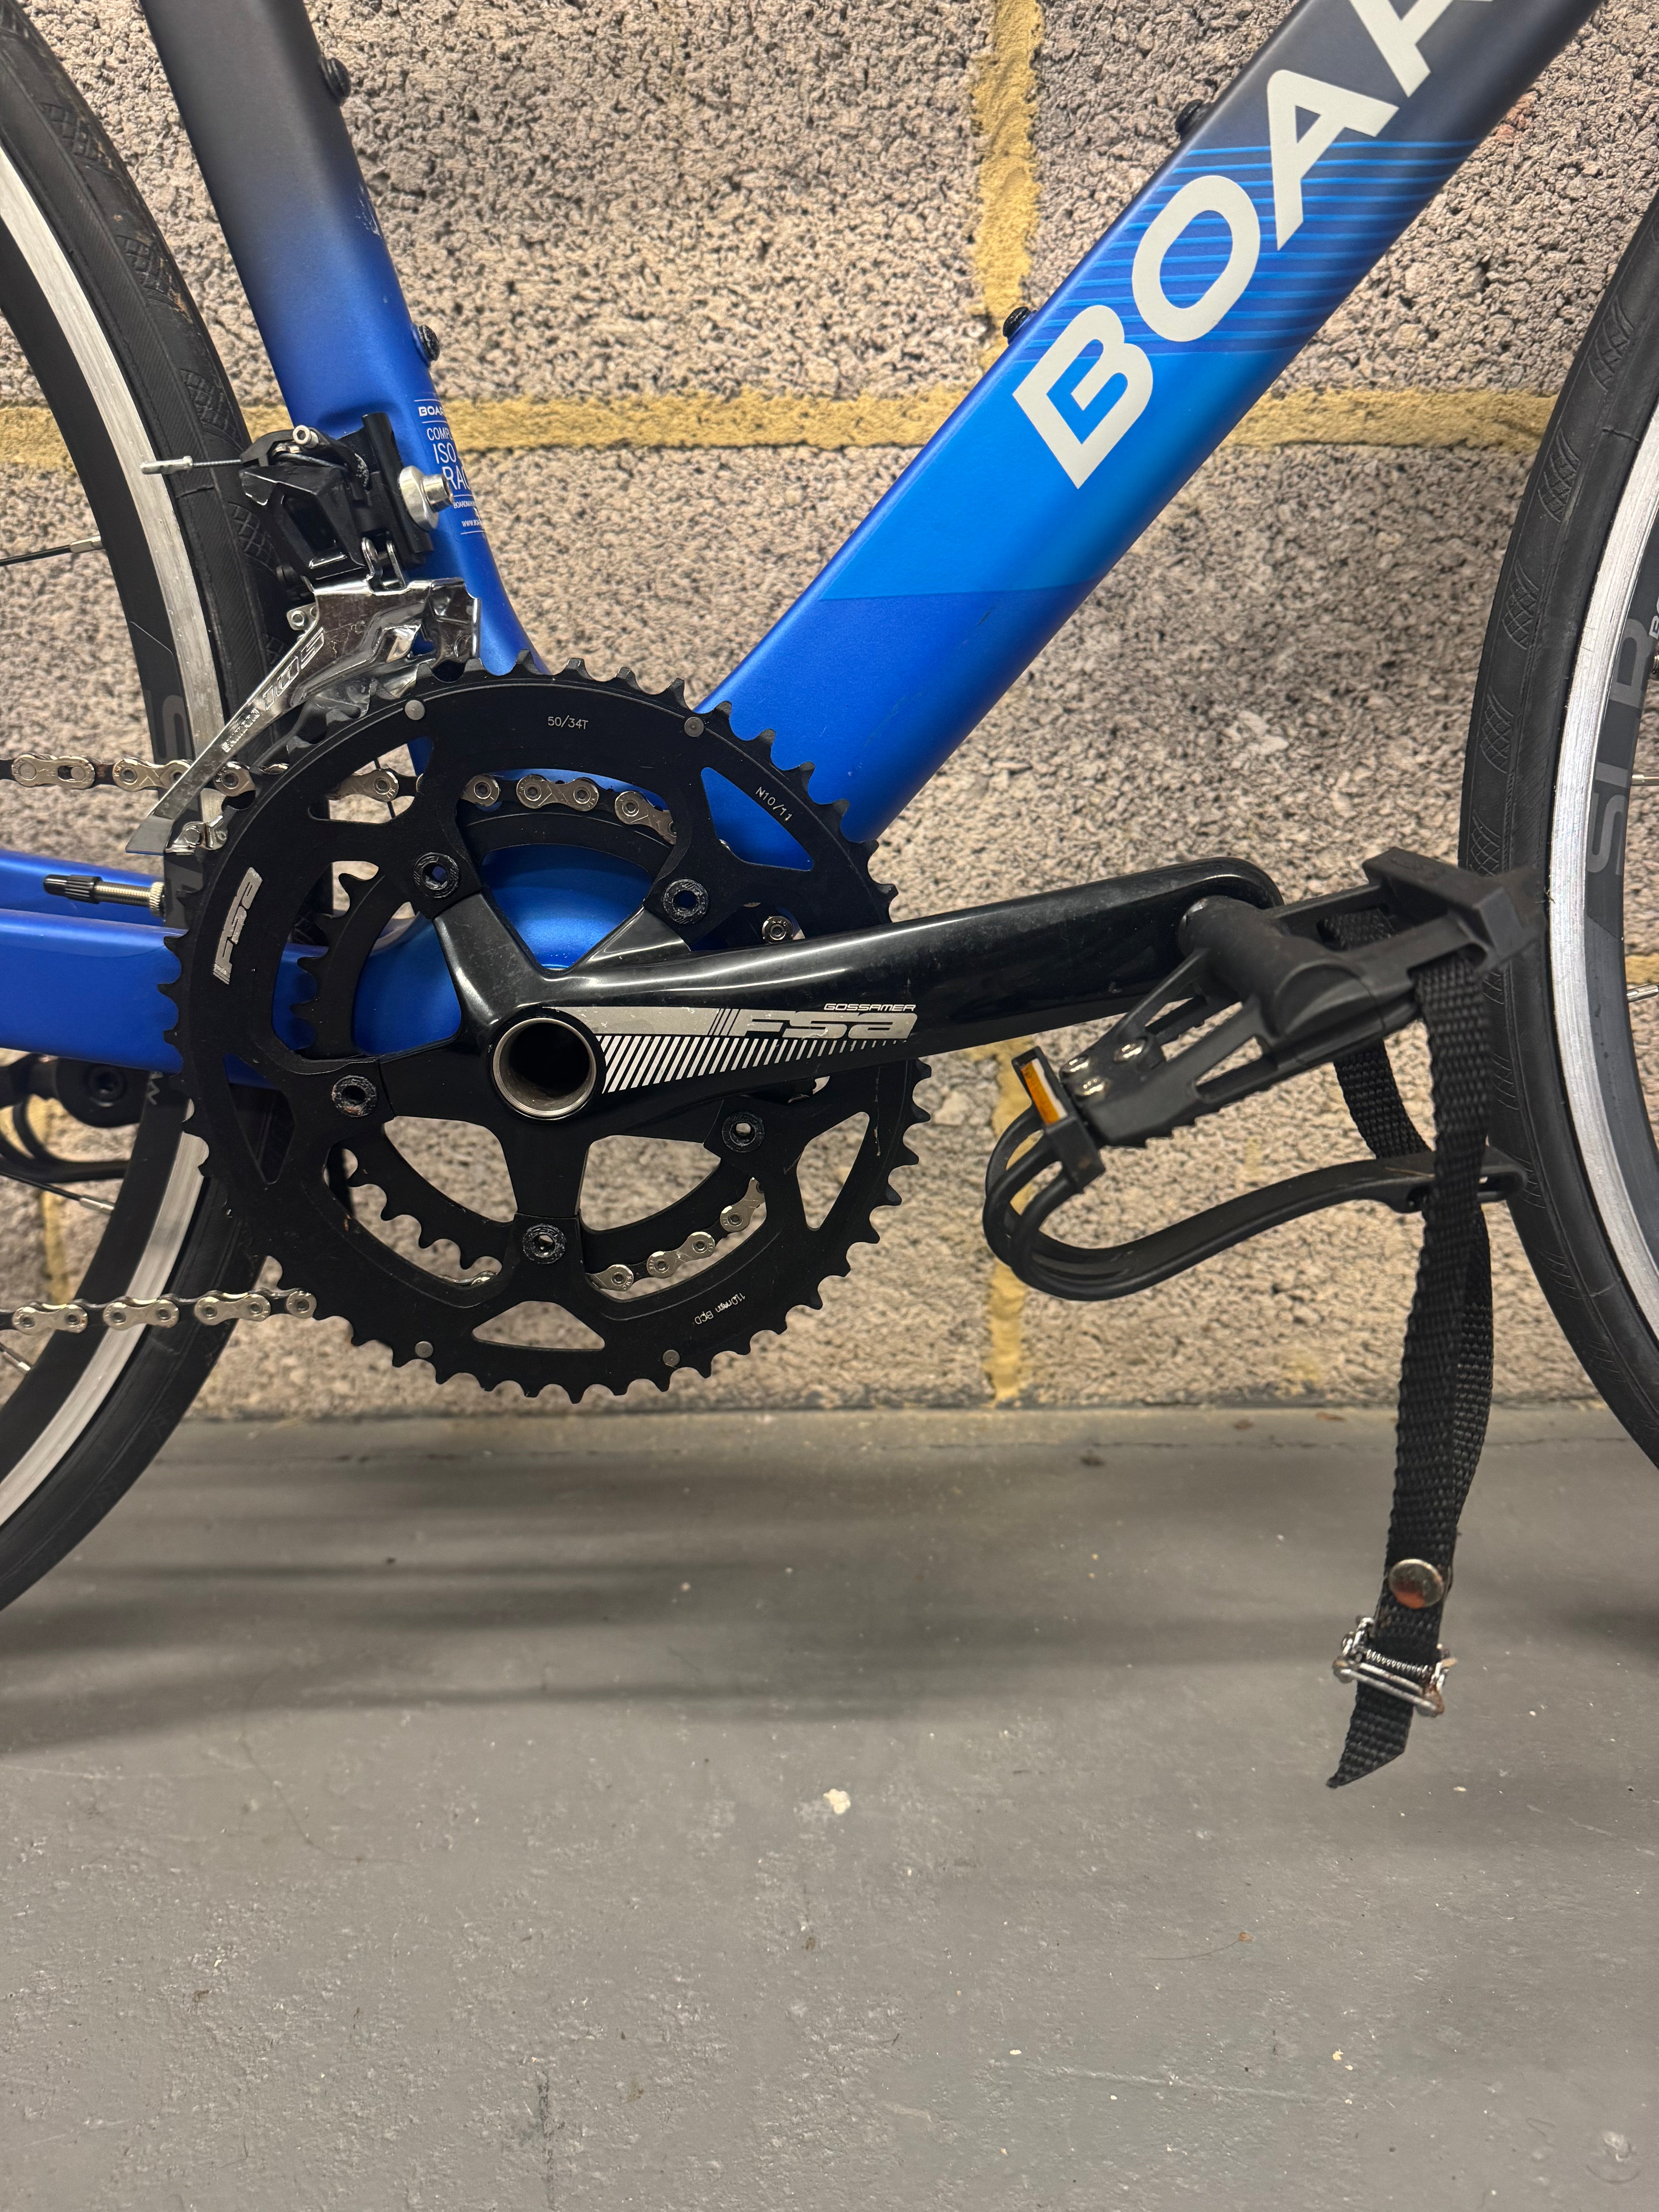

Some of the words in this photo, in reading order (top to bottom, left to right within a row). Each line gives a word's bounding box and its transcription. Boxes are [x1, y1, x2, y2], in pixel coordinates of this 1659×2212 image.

[433, 443, 456, 464] ISO
[263, 627, 324, 710] 105
[548, 715, 589, 730] 50/34T
[756, 787, 792, 821] N10/11
[824, 1003, 916, 1012] GOSSAMER
[694, 1310, 714, 1324] BCD
